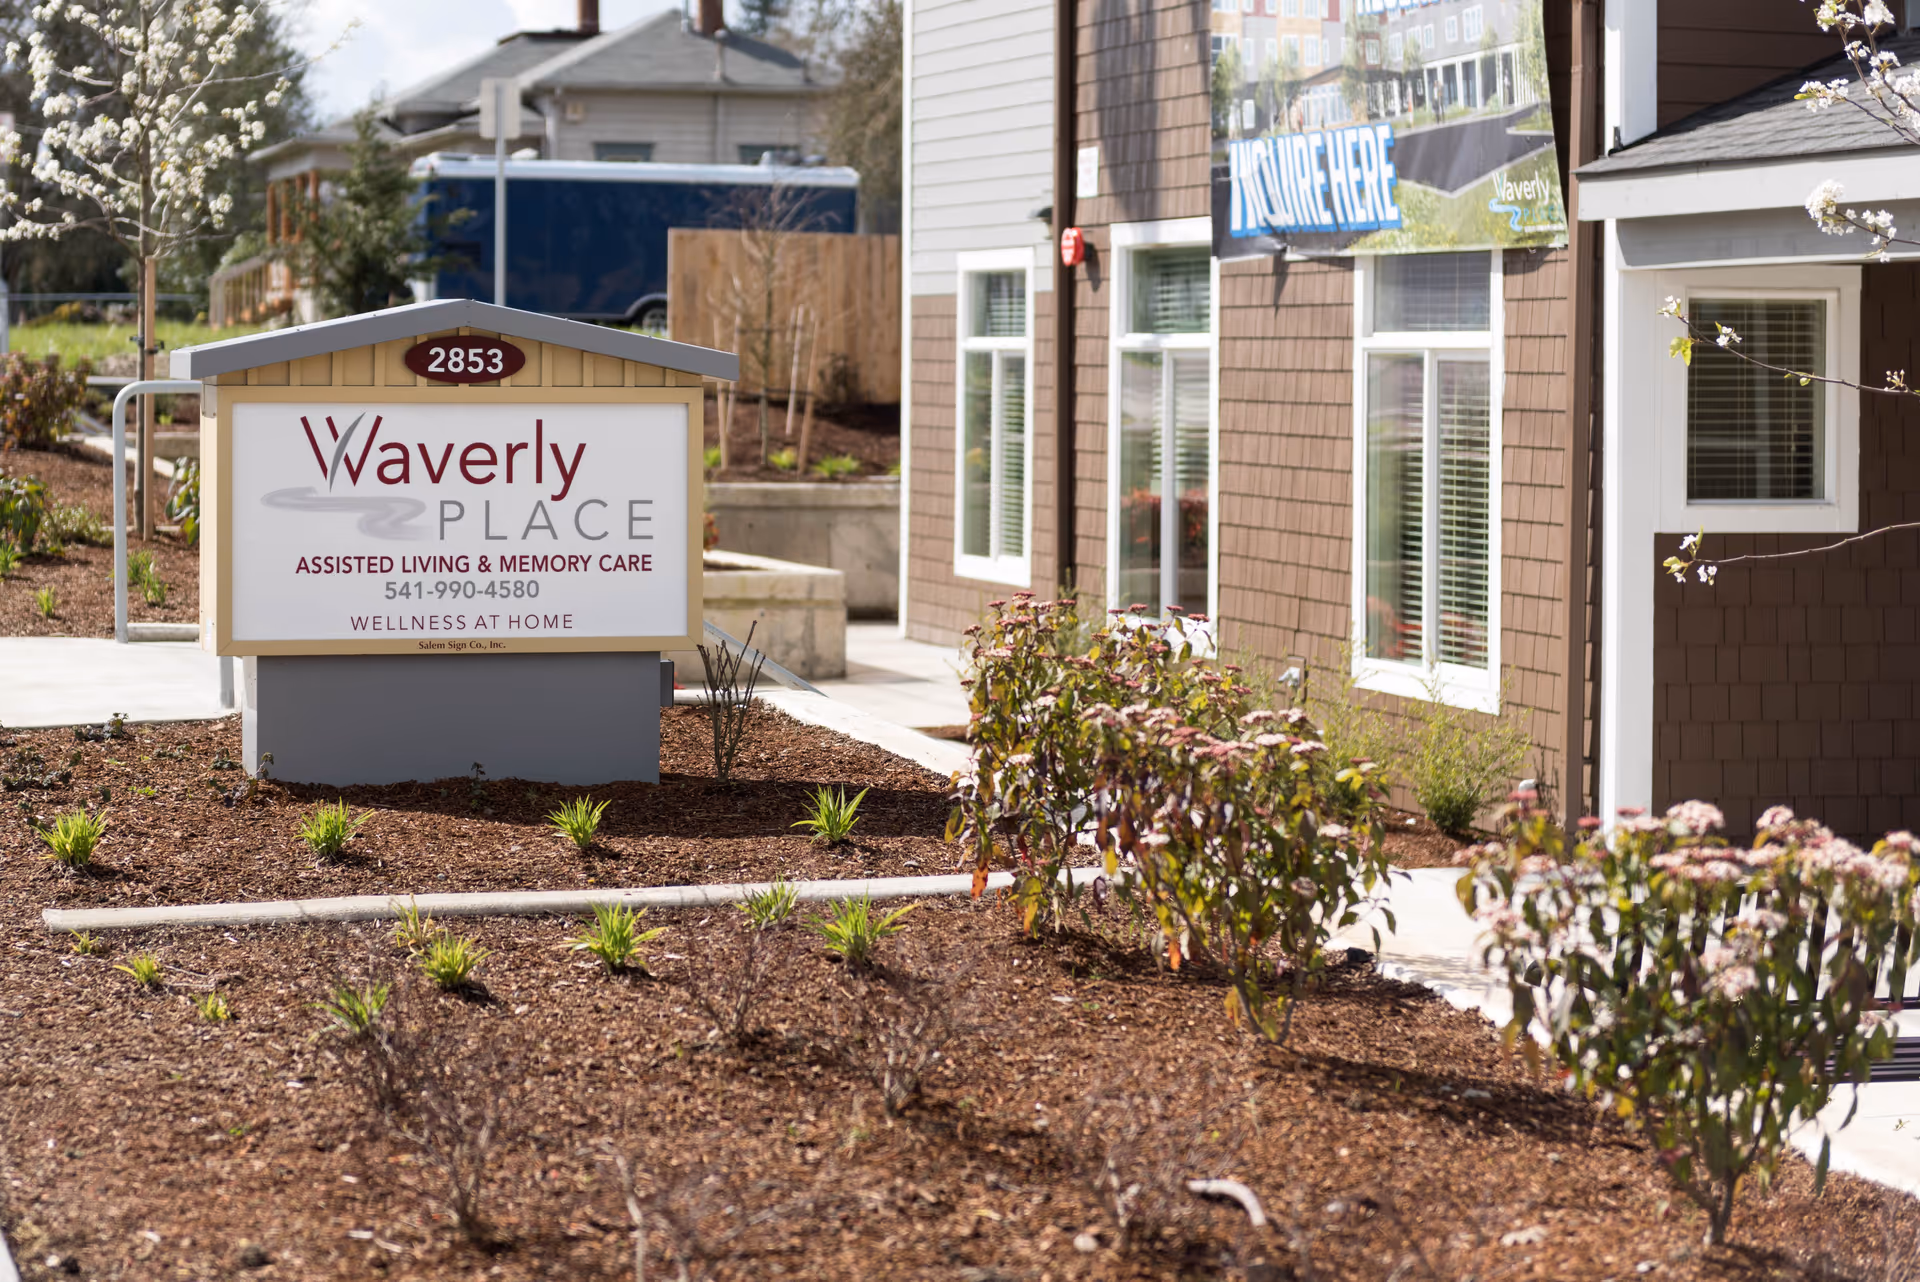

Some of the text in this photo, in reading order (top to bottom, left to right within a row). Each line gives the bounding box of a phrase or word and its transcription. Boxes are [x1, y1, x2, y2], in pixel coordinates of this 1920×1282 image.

[1326, 123, 1401, 231] HERE
[1492, 170, 1549, 205] Waverly
[428, 347, 504, 373] 2853
[300, 412, 586, 501] Waverly
[440, 499, 653, 540] PLACE
[295, 554, 652, 574] ASSISTED LIVING & MEMORY CARE
[385, 580, 539, 599] 541-990-4580
[351, 614, 572, 631] WELLNESS AT HOME
[418, 641, 506, 651] Salem Sign Co., Inc.
